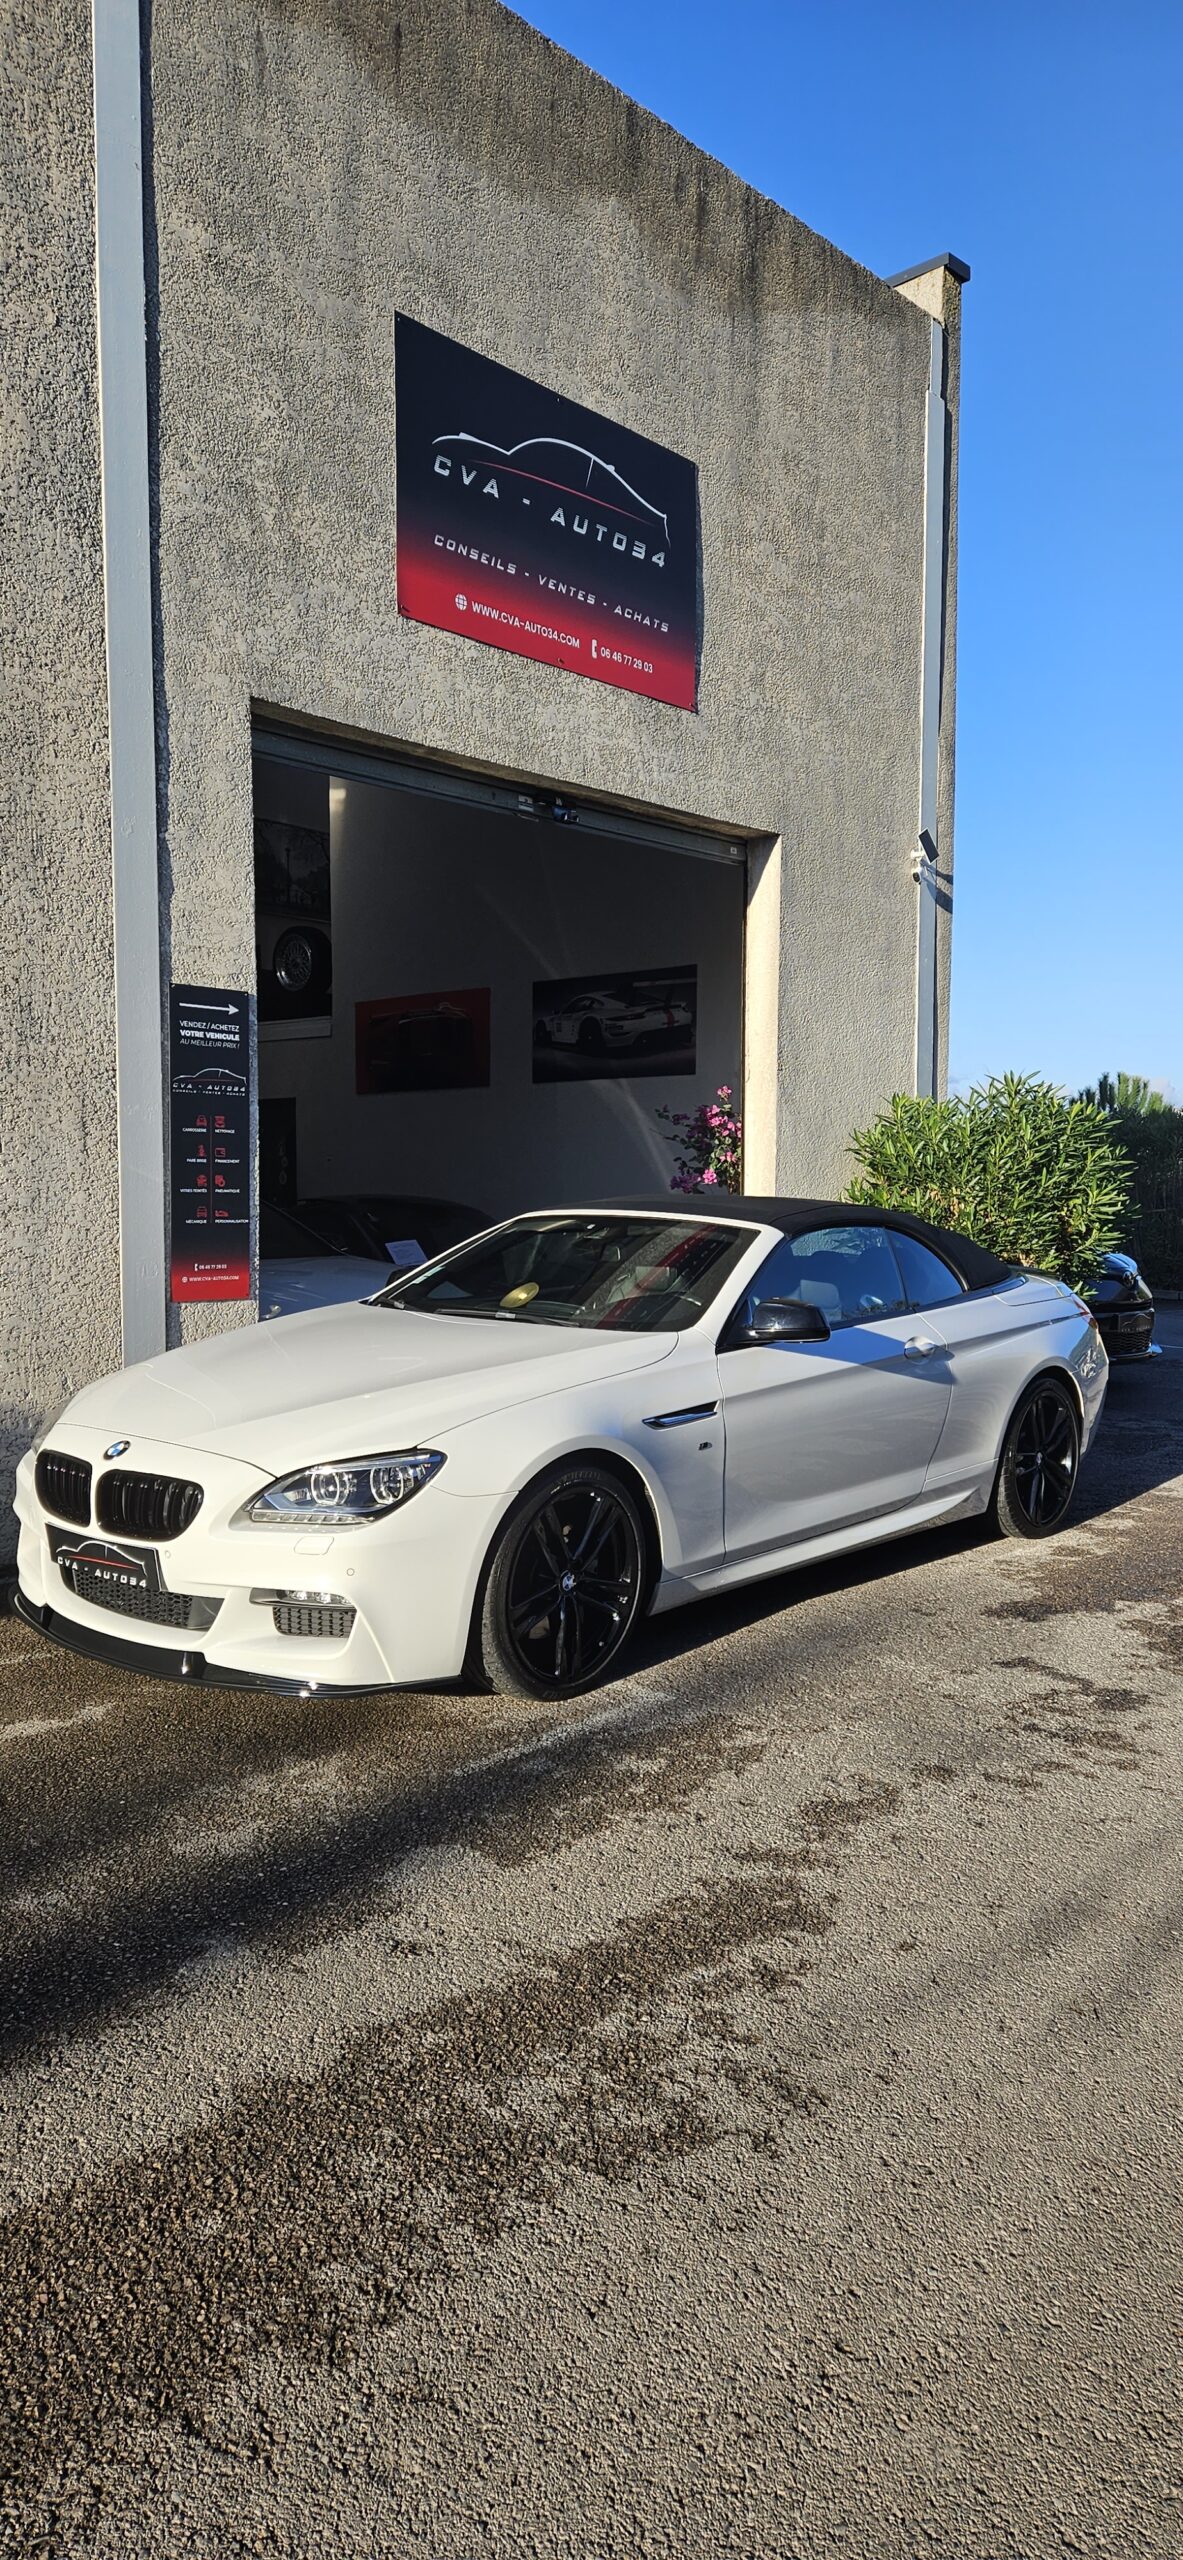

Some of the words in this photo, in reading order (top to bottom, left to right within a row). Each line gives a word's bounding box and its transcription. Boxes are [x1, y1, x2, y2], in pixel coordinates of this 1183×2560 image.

[434, 455, 499, 498] CVA
[550, 507, 665, 567] AUTO34
[434, 534, 517, 575] CONSEILS
[539, 574, 596, 605] VENTES
[614, 605, 669, 633] ACHATS
[472, 600, 580, 648] WWW.CVA-AUTO34.COM
[600, 647, 611, 659] 06
[612, 650, 622, 663] 46
[623, 654, 632, 667] 77
[633, 656, 643, 669] 29
[644, 659, 653, 673] 03
[180, 1020, 206, 1030] VENDEZ
[211, 1023, 240, 1032] ACHETEZ
[180, 1029, 205, 1039] VOTRE
[205, 1031, 240, 1041] VEHICULE
[191, 1040, 222, 1048] MEILLEUR
[57, 1556, 78, 1570] CVA
[95, 1569, 147, 1588] AUTO34
